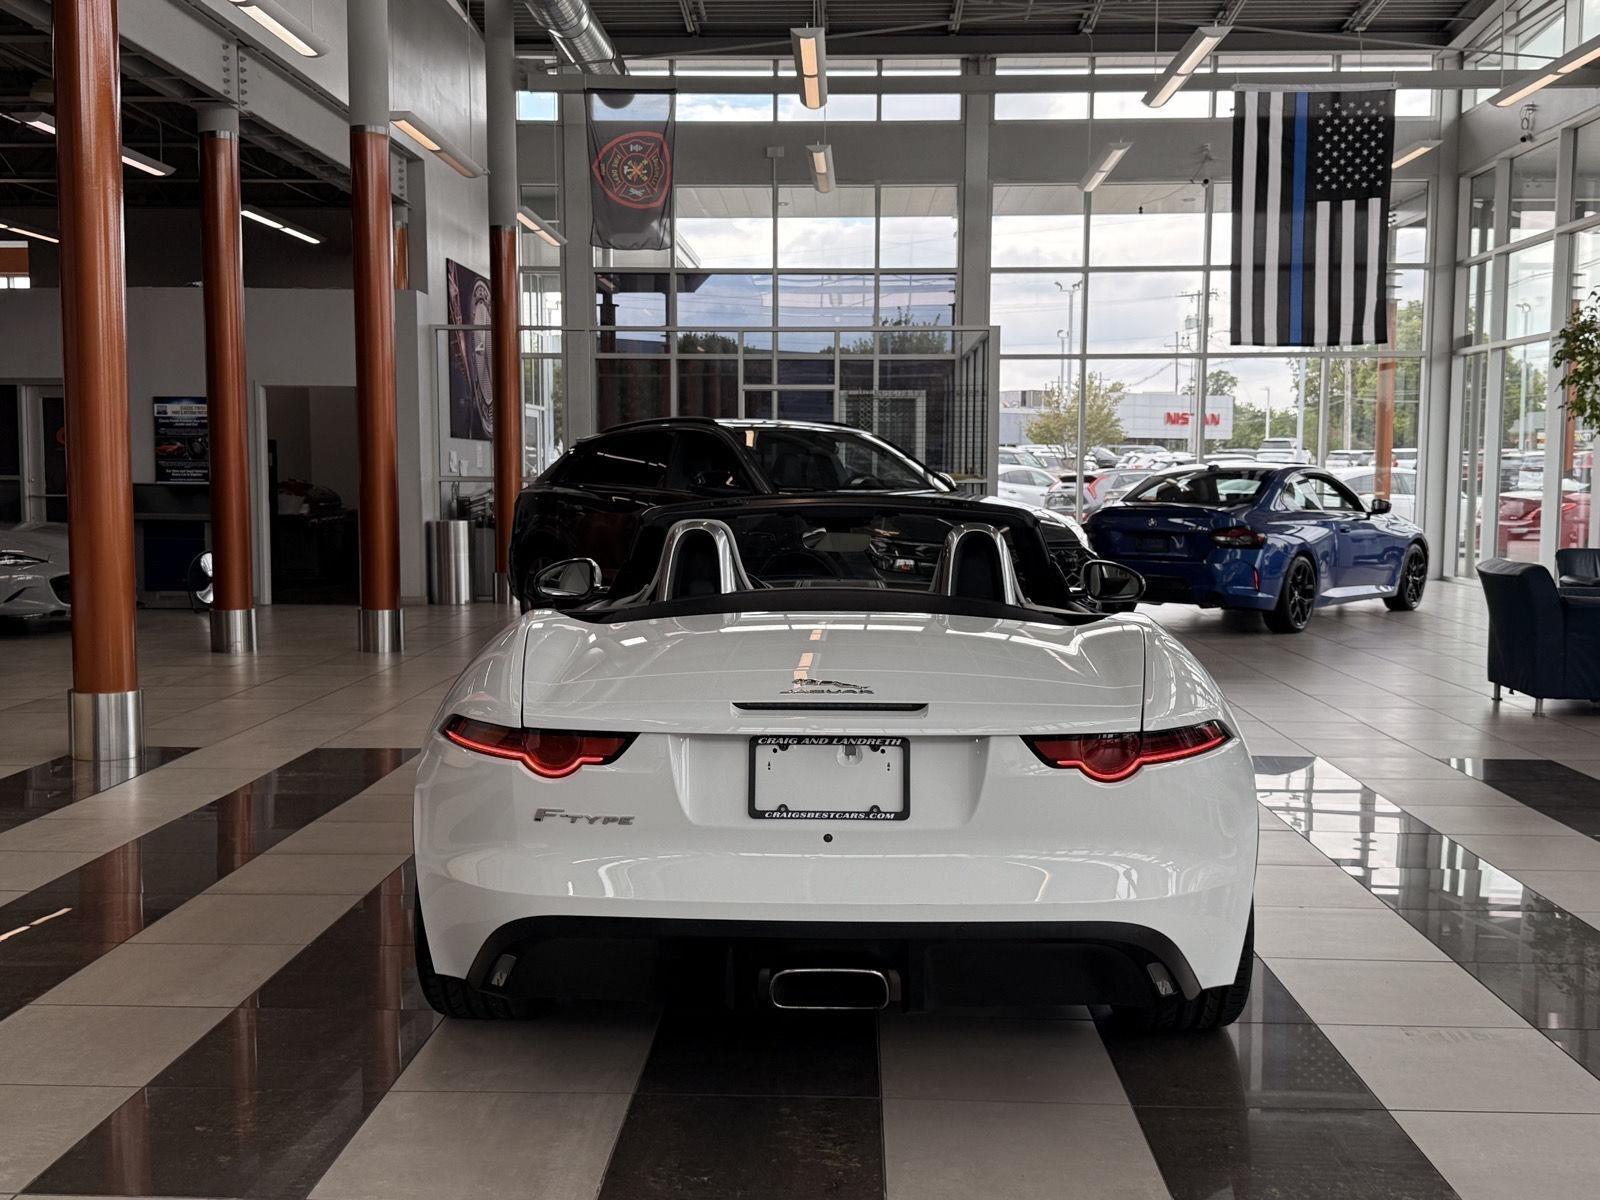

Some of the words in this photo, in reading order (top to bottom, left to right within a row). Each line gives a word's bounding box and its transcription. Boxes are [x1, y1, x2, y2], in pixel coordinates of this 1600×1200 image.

[1164, 412, 1220, 425] NISAN
[758, 737, 799, 745] CRAIG
[801, 737, 829, 745] AND
[832, 738, 902, 746] LANDRETH
[533, 808, 635, 825] F-TYPE
[764, 811, 896, 820] CRAIGSBESTCARS.COM
